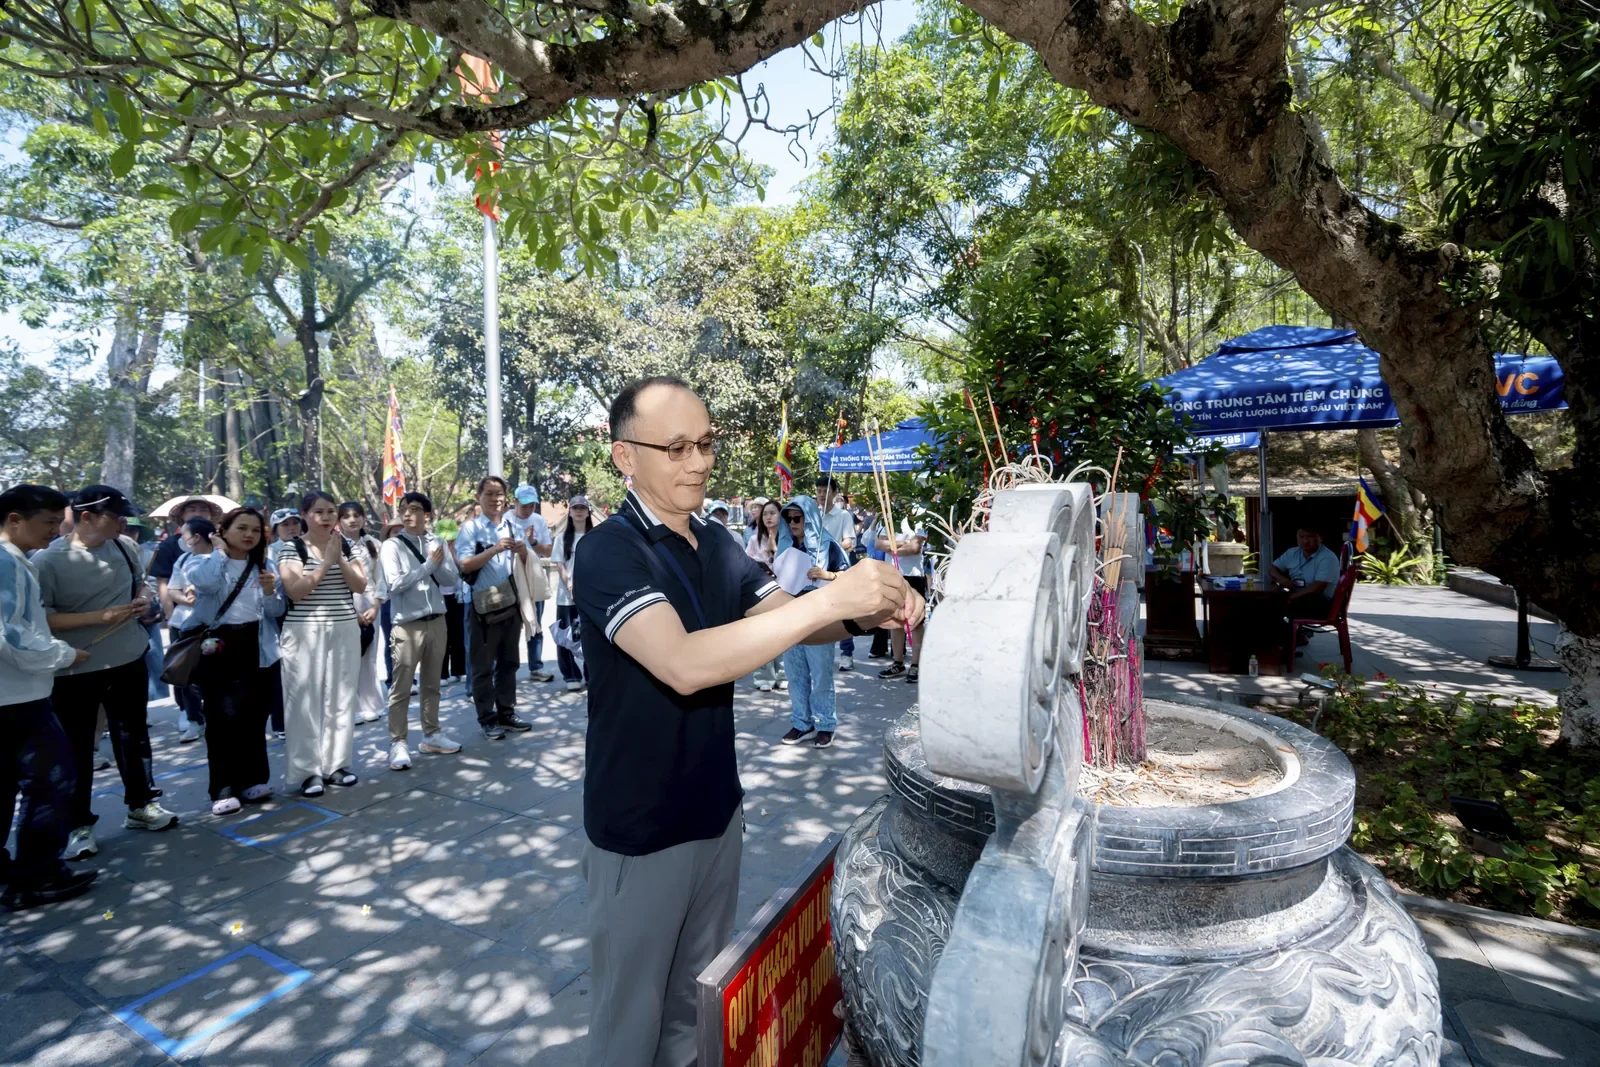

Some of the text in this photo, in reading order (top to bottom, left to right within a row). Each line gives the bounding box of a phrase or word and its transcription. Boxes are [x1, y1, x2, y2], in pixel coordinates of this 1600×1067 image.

[1496, 372, 1539, 396] VC
[1163, 385, 1384, 412] ỐNG TRUNG TÂM TIÊM CHỦNG
[1197, 412, 1212, 421] TÍN
[1219, 409, 1244, 419] CHẤT
[1245, 408, 1278, 417] LƯỢNG
[1280, 405, 1308, 414] HÀNG
[1333, 402, 1356, 412] VIỆT
[728, 874, 834, 1052] QUÝ KHÁCH VUI LÒN
[810, 940, 837, 1007] HƯƠN
